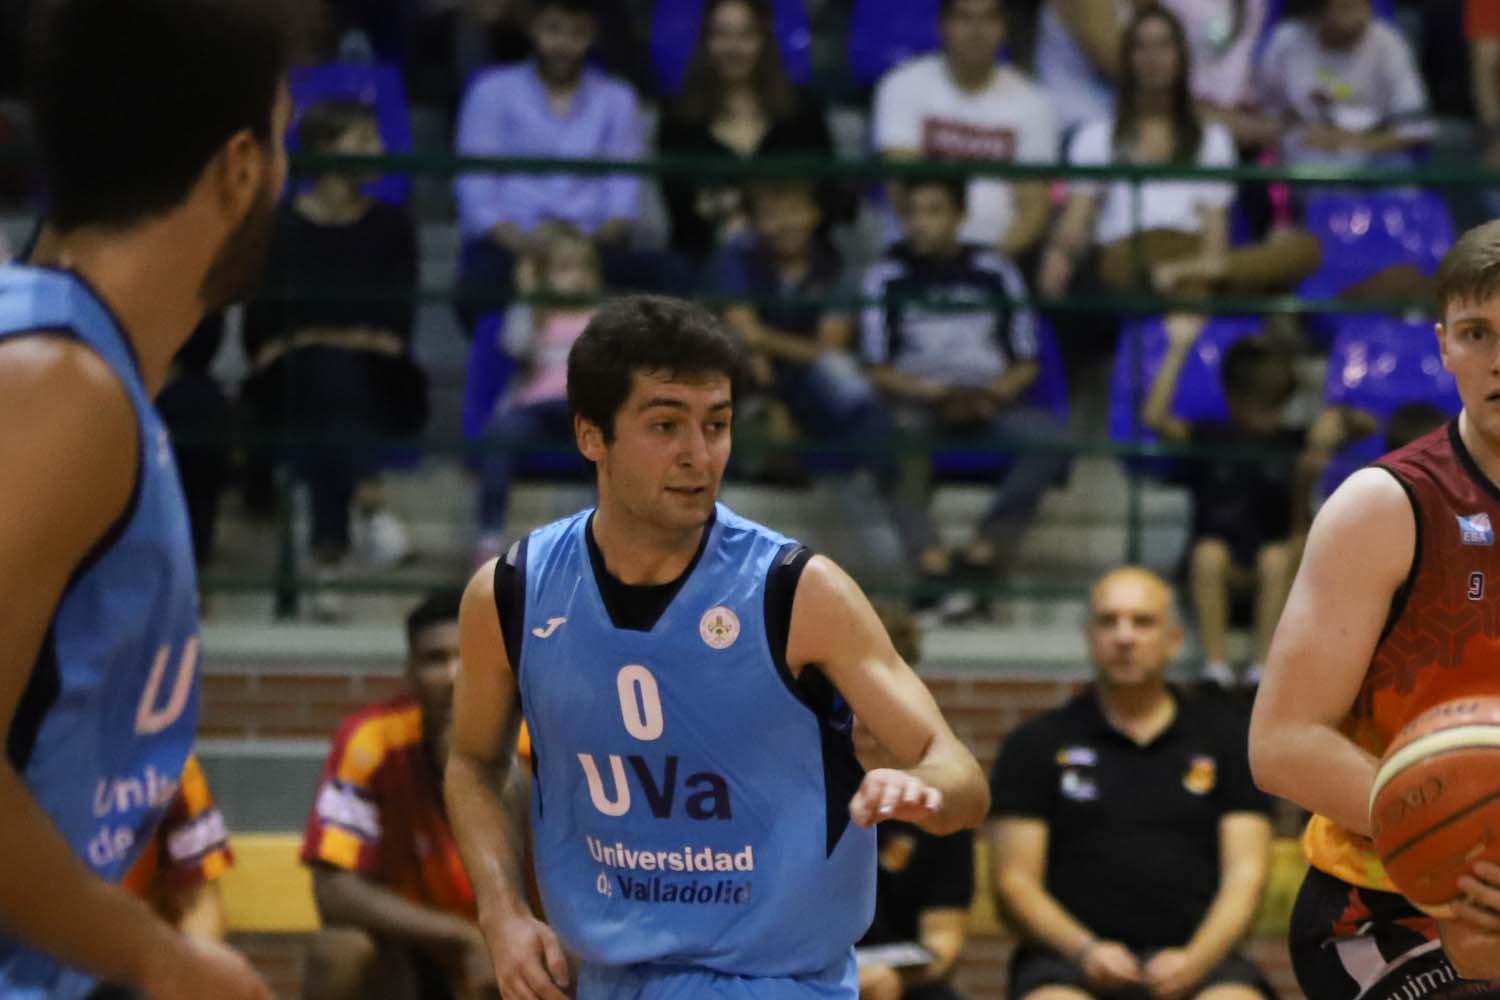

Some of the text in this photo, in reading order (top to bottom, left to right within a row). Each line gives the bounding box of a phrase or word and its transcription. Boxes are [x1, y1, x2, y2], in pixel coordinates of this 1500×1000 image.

[616, 664, 664, 741] 0
[577, 752, 733, 820] UVa
[585, 834, 753, 872] Universidad
